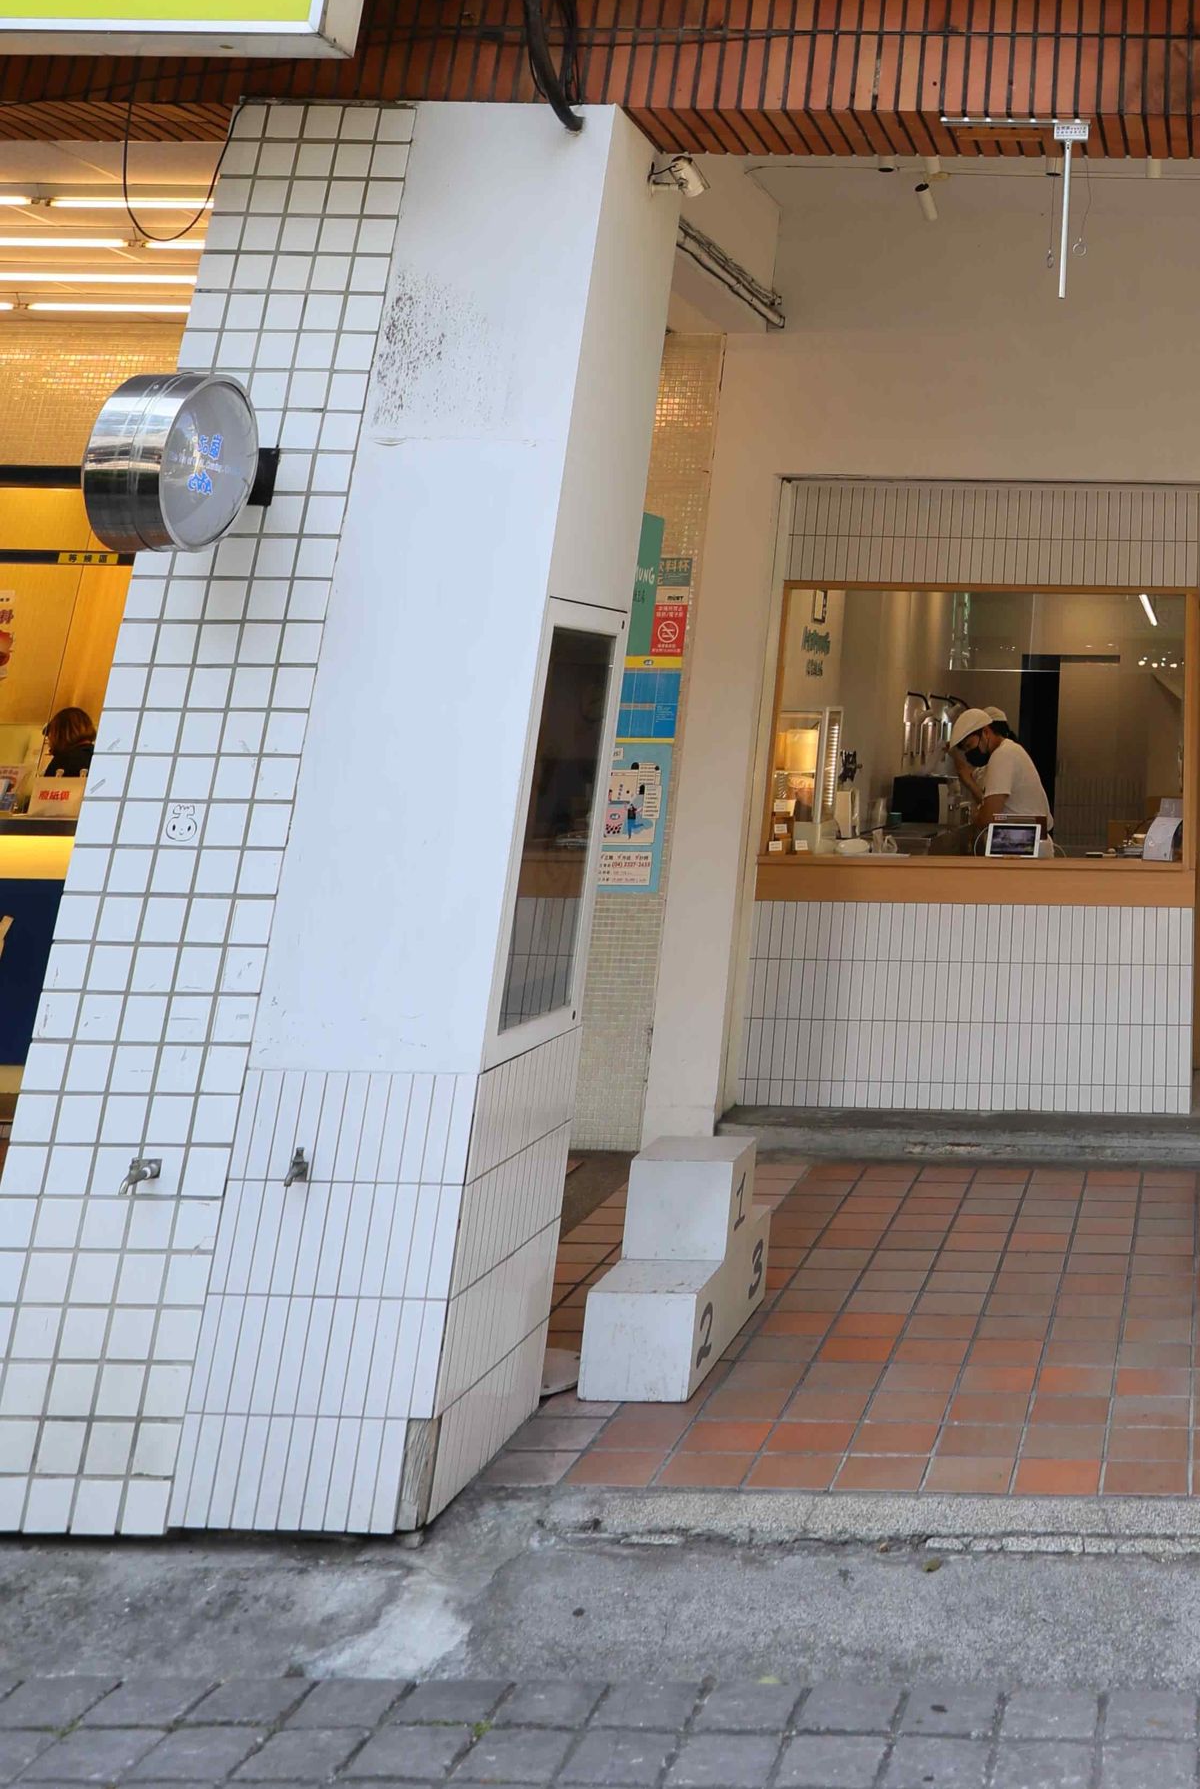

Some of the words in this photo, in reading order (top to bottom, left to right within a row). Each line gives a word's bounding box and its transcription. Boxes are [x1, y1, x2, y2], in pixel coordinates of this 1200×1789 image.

[734, 1171, 746, 1232] 1
[749, 1238, 763, 1300] 3
[696, 1302, 713, 1369] 2
